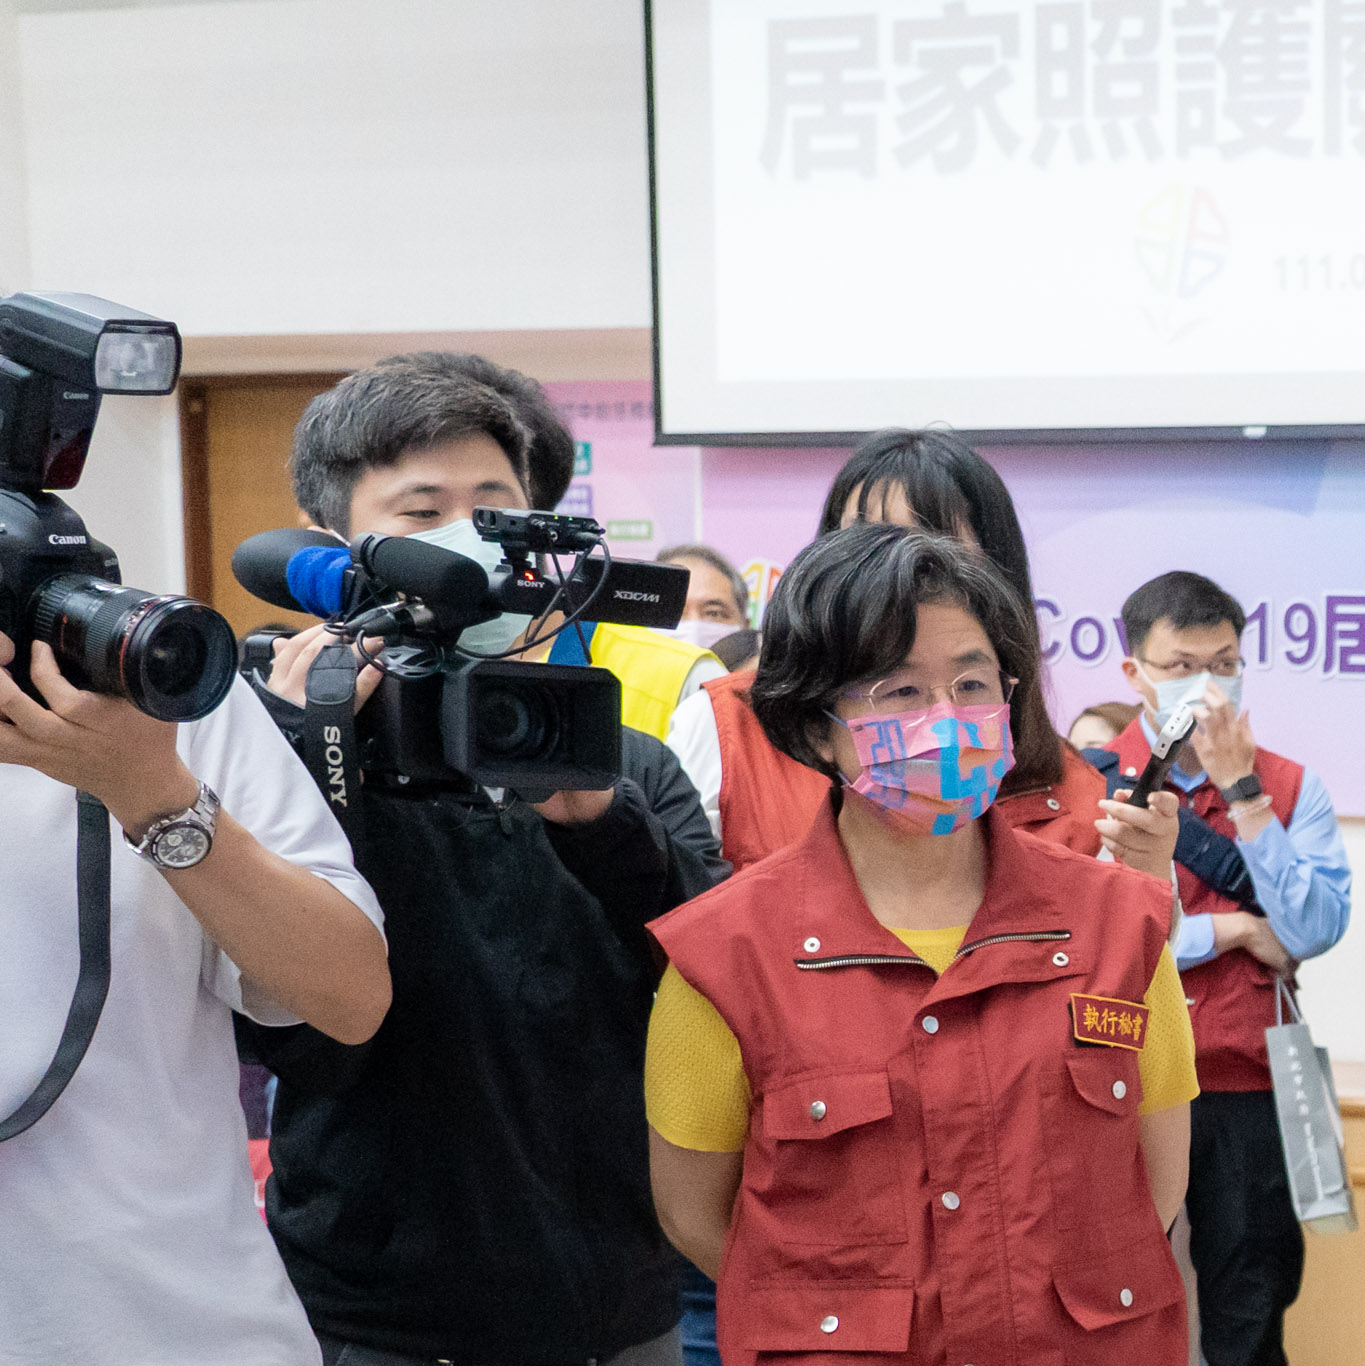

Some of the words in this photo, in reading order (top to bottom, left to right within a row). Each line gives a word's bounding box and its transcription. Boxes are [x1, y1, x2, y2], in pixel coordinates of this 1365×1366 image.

[63, 391, 90, 400] Canon
[48, 534, 87, 545] Canon
[517, 580, 545, 588] SONY
[613, 590, 660, 604] XDCAM
[324, 726, 347, 808] SONY
[1083, 1003, 1143, 1041] 執行秘書
